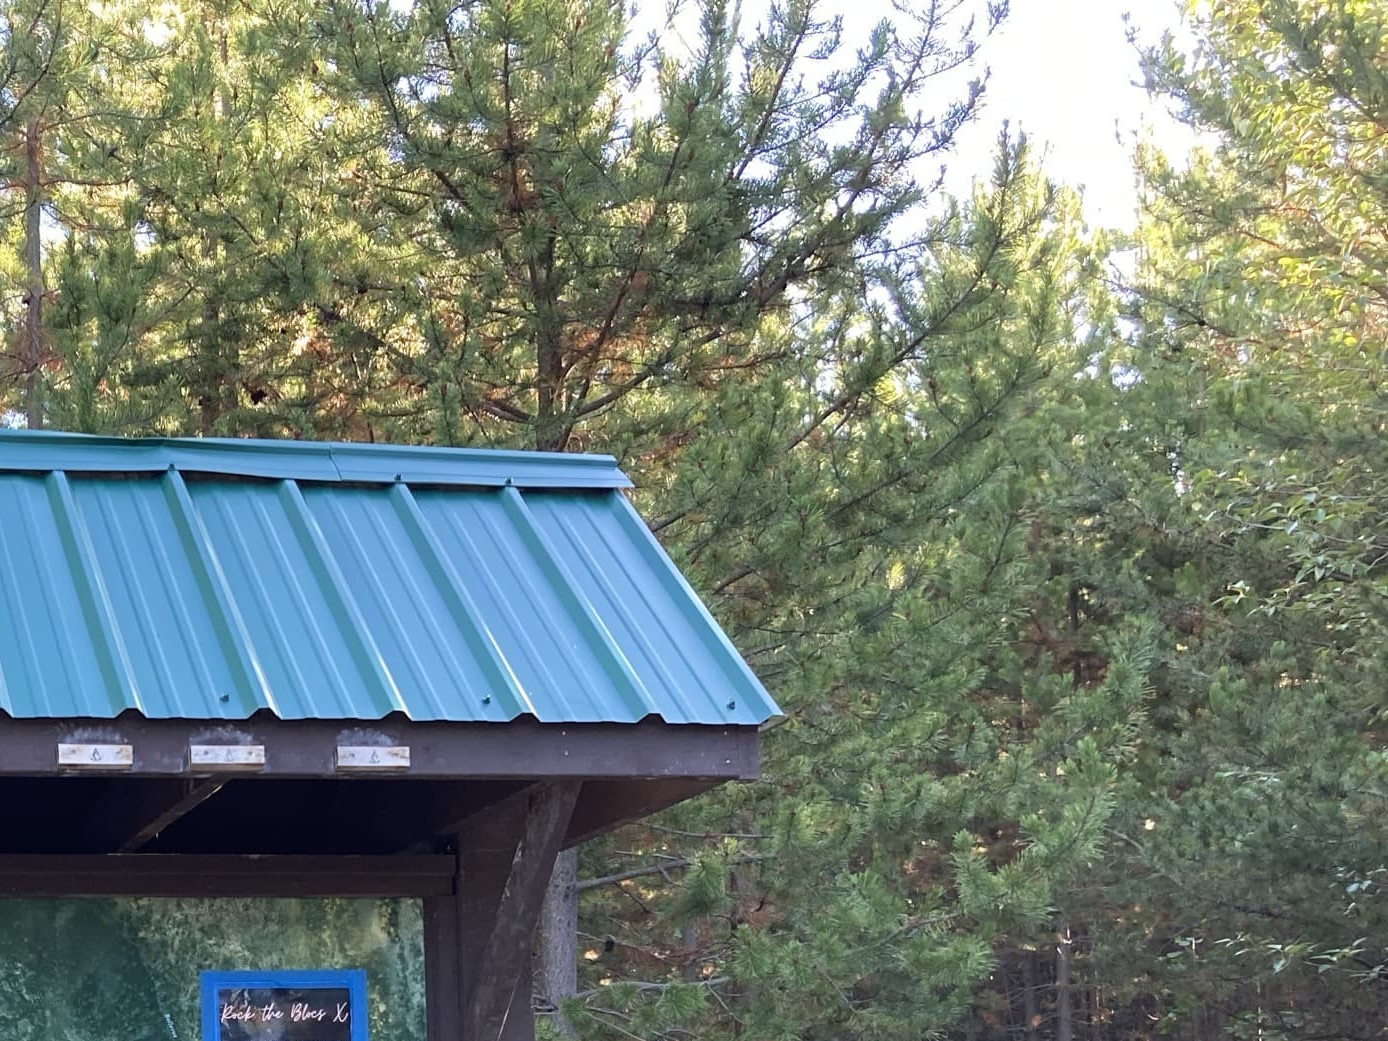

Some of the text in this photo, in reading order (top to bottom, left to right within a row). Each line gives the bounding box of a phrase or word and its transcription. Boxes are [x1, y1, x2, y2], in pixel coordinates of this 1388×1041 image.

[220, 1001, 349, 1023] Rock the Blocs X
